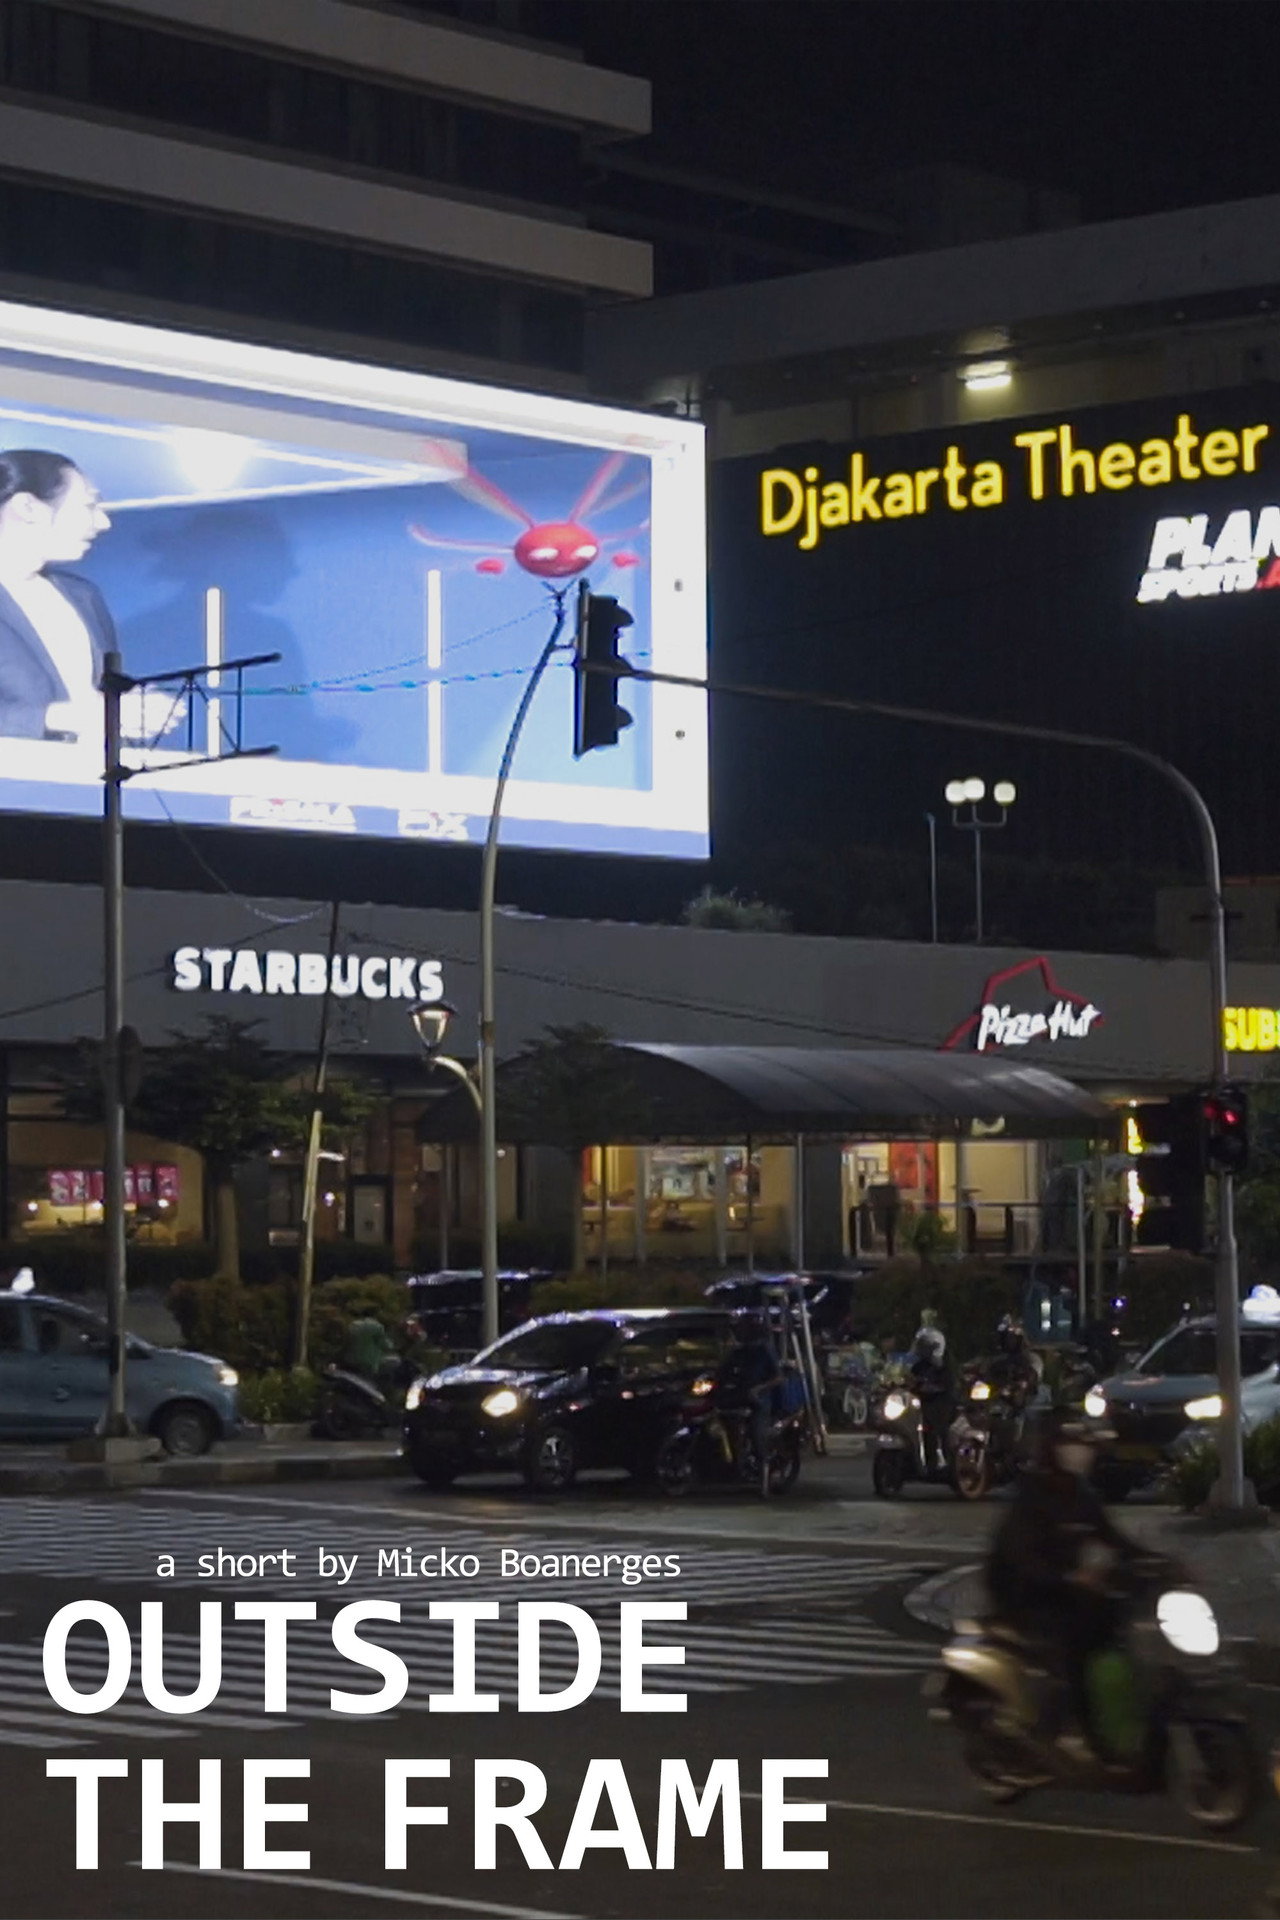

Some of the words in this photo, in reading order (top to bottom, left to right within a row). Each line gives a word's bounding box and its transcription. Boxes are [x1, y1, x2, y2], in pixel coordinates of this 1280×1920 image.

[761, 446, 1003, 550] Djakarta
[1014, 414, 1269, 500] Theater
[174, 946, 444, 1000] STARBUCKS
[977, 1004, 1047, 1051] Pizza
[1047, 1000, 1100, 1041] Hut
[1222, 1006, 1280, 1052] SUB
